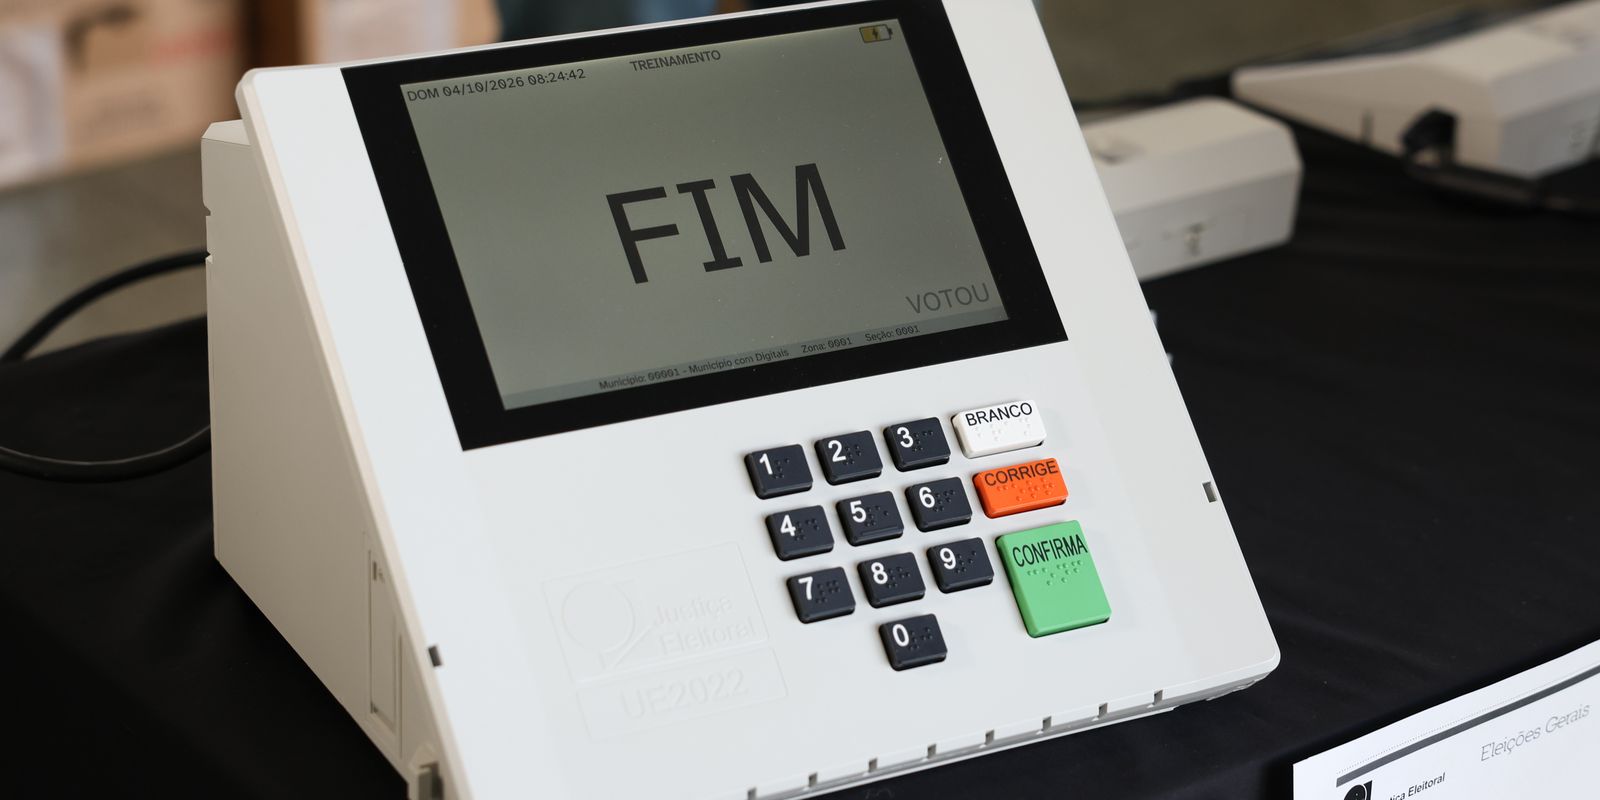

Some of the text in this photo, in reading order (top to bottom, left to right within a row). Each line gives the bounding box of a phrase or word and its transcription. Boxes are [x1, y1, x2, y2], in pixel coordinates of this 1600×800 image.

[630, 49, 722, 73] TREINAMENTO
[407, 68, 587, 102] DOM 04/10/2026 08:24:42
[605, 163, 847, 285] FIM
[906, 283, 990, 315] VOTOU
[599, 375, 645, 391] Município:
[648, 368, 680, 382] 00001
[689, 359, 732, 375] Município
[734, 356, 755, 367] com
[756, 348, 789, 362] Digitais
[801, 343, 827, 355] Zona:
[828, 336, 852, 350] 0001
[865, 331, 896, 346] Seção:
[896, 325, 920, 337] 0001
[965, 402, 1033, 427] BRANCO
[897, 427, 914, 449] 3
[828, 440, 846, 463] 2
[759, 454, 773, 475] 1
[984, 460, 1058, 488] CORRIGE
[919, 487, 936, 509] 6
[850, 501, 867, 523] 5
[780, 515, 796, 537] 4
[940, 548, 957, 570] 9
[1012, 534, 1088, 568] CONFIRMA
[871, 562, 888, 585] 8
[799, 577, 813, 600] 7
[653, 595, 733, 626] Justiça
[659, 617, 756, 654] Eleitoral
[892, 624, 910, 647] 0
[620, 669, 749, 719] UE2022
[1481, 703, 1591, 762] Eleições Gerais
[1408, 772, 1446, 796] Eleitoral
